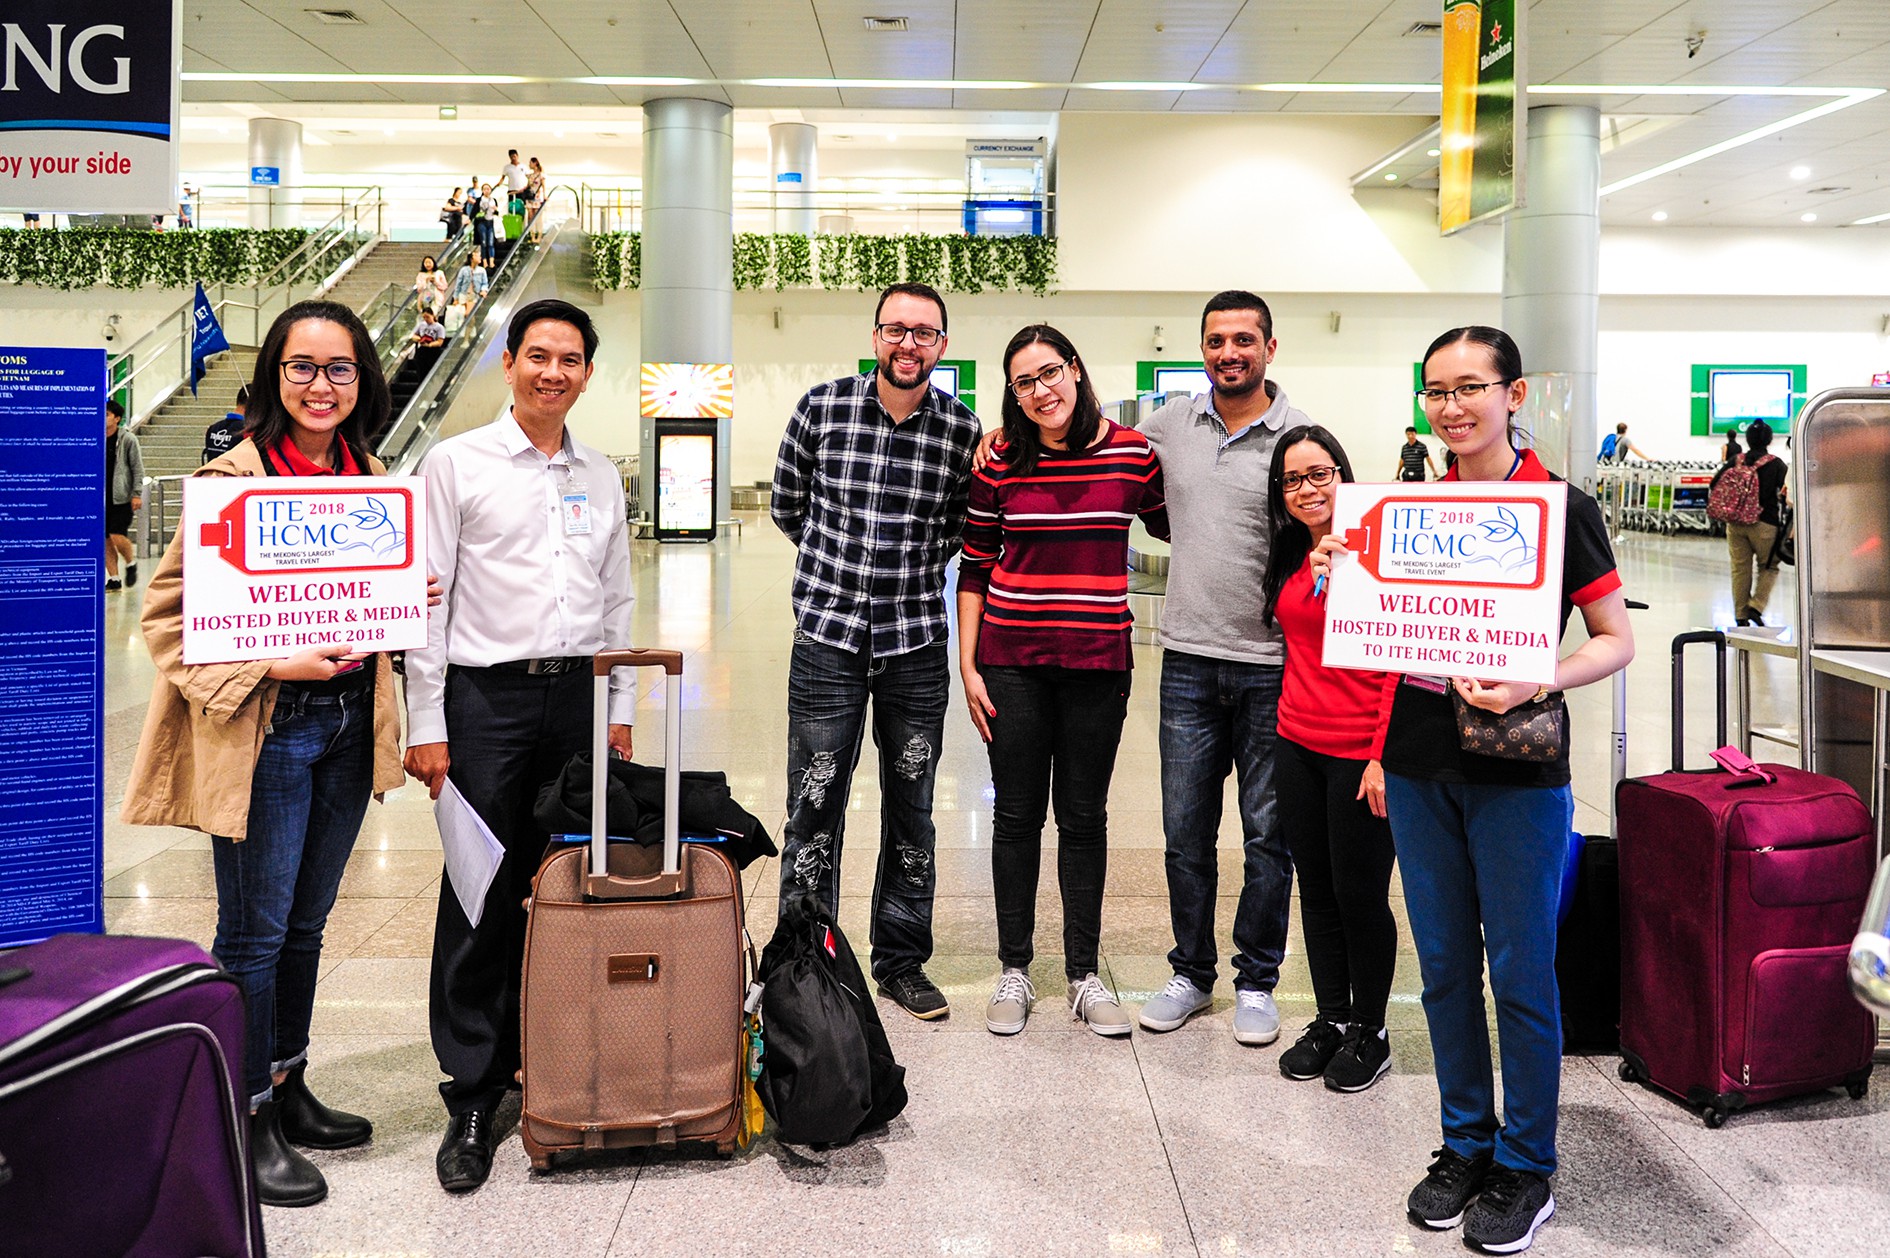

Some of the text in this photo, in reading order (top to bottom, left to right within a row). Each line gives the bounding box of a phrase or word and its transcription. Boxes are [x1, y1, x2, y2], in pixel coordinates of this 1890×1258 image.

[1, 23, 131, 94] NG
[1480, 41, 1512, 71] Heineken
[30, 156, 79, 178] your
[86, 151, 131, 174] side
[0, 355, 27, 365] OMS
[258, 501, 345, 522] ITE 2018
[1393, 508, 1474, 530] ITE 2018
[259, 523, 349, 547] HCMC
[1391, 533, 1477, 558] HCMC
[248, 581, 372, 604] WELCOME
[1379, 593, 1496, 618] WELCOME
[192, 605, 421, 632] HOSTED BUYER & MEDIA
[233, 628, 385, 649] TO ITE HCMC 2018
[1332, 619, 1549, 648] HOSTED BUYER & MEDIA
[1363, 643, 1507, 668] TO ITE HCMC 2018
